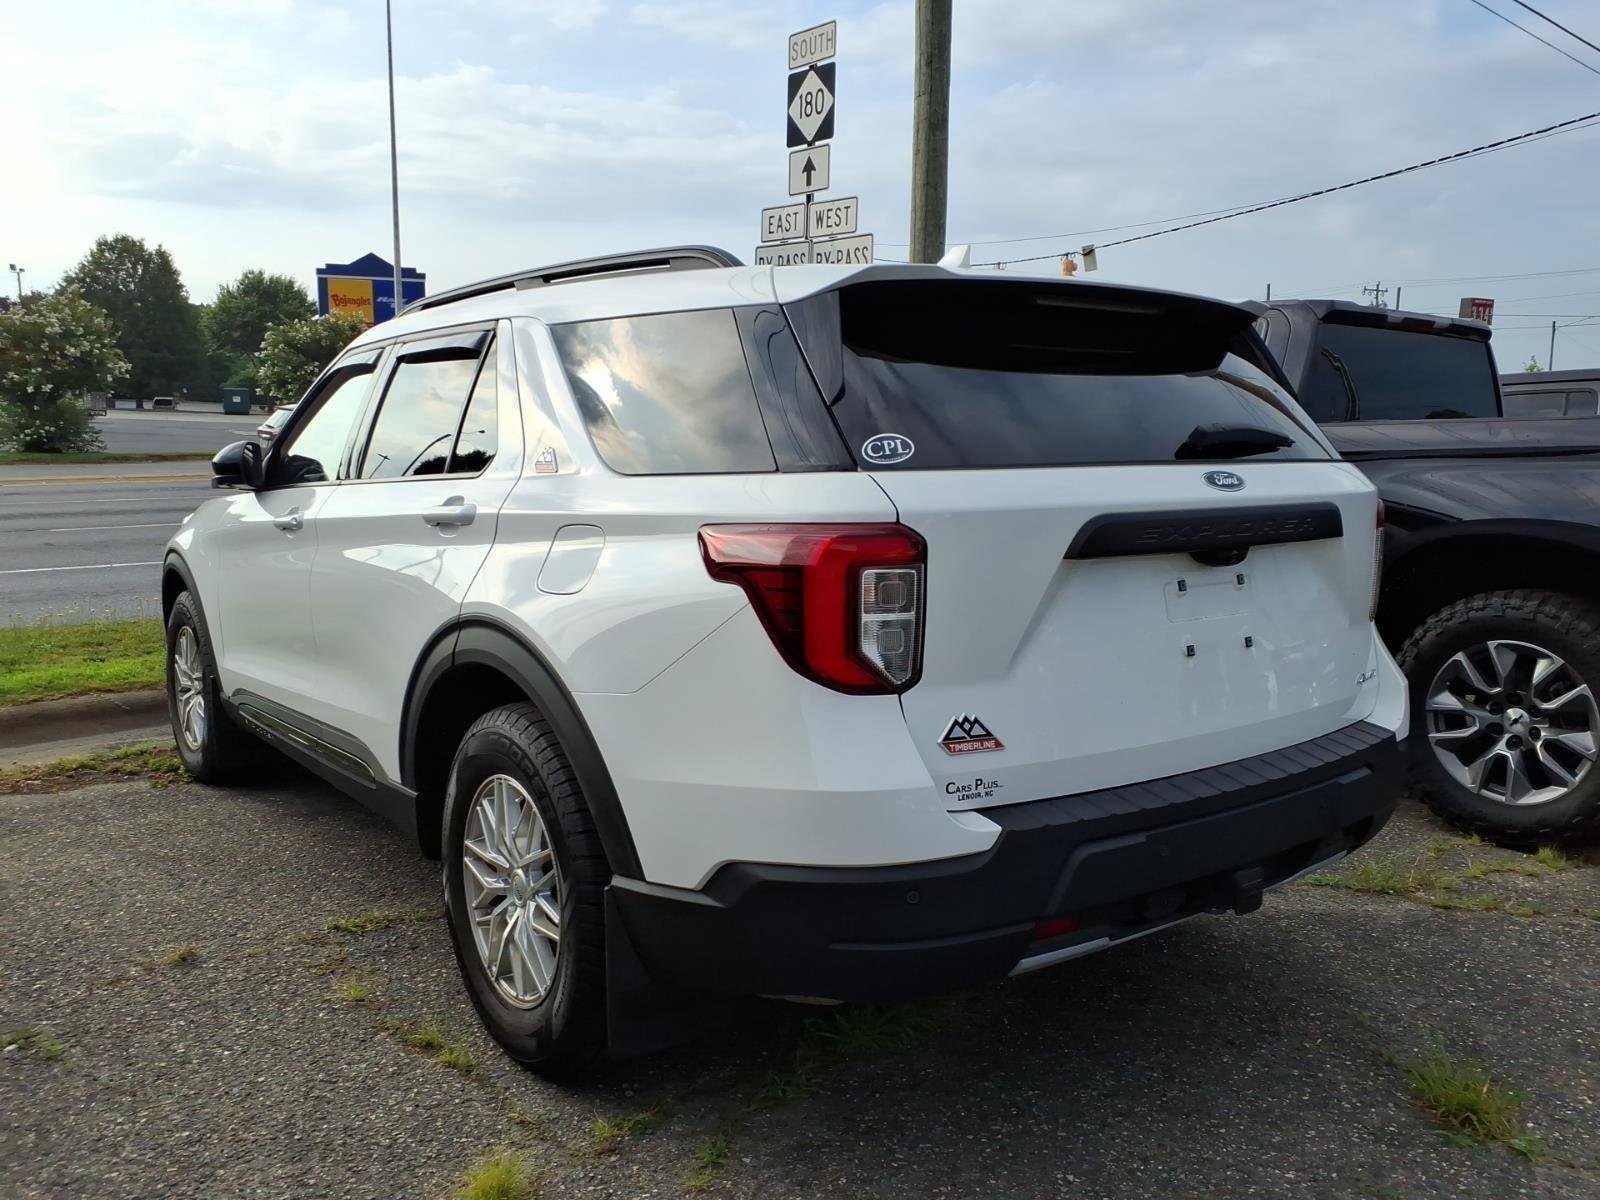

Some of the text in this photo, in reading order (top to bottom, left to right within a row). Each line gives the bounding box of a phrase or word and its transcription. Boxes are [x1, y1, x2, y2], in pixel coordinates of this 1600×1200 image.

[791, 29, 834, 62] SOUTH
[798, 88, 825, 120] 180
[768, 211, 799, 235] EAST
[815, 205, 851, 230] WEST
[866, 439, 910, 457] CPL
[949, 740, 996, 752] TIMBERLINE
